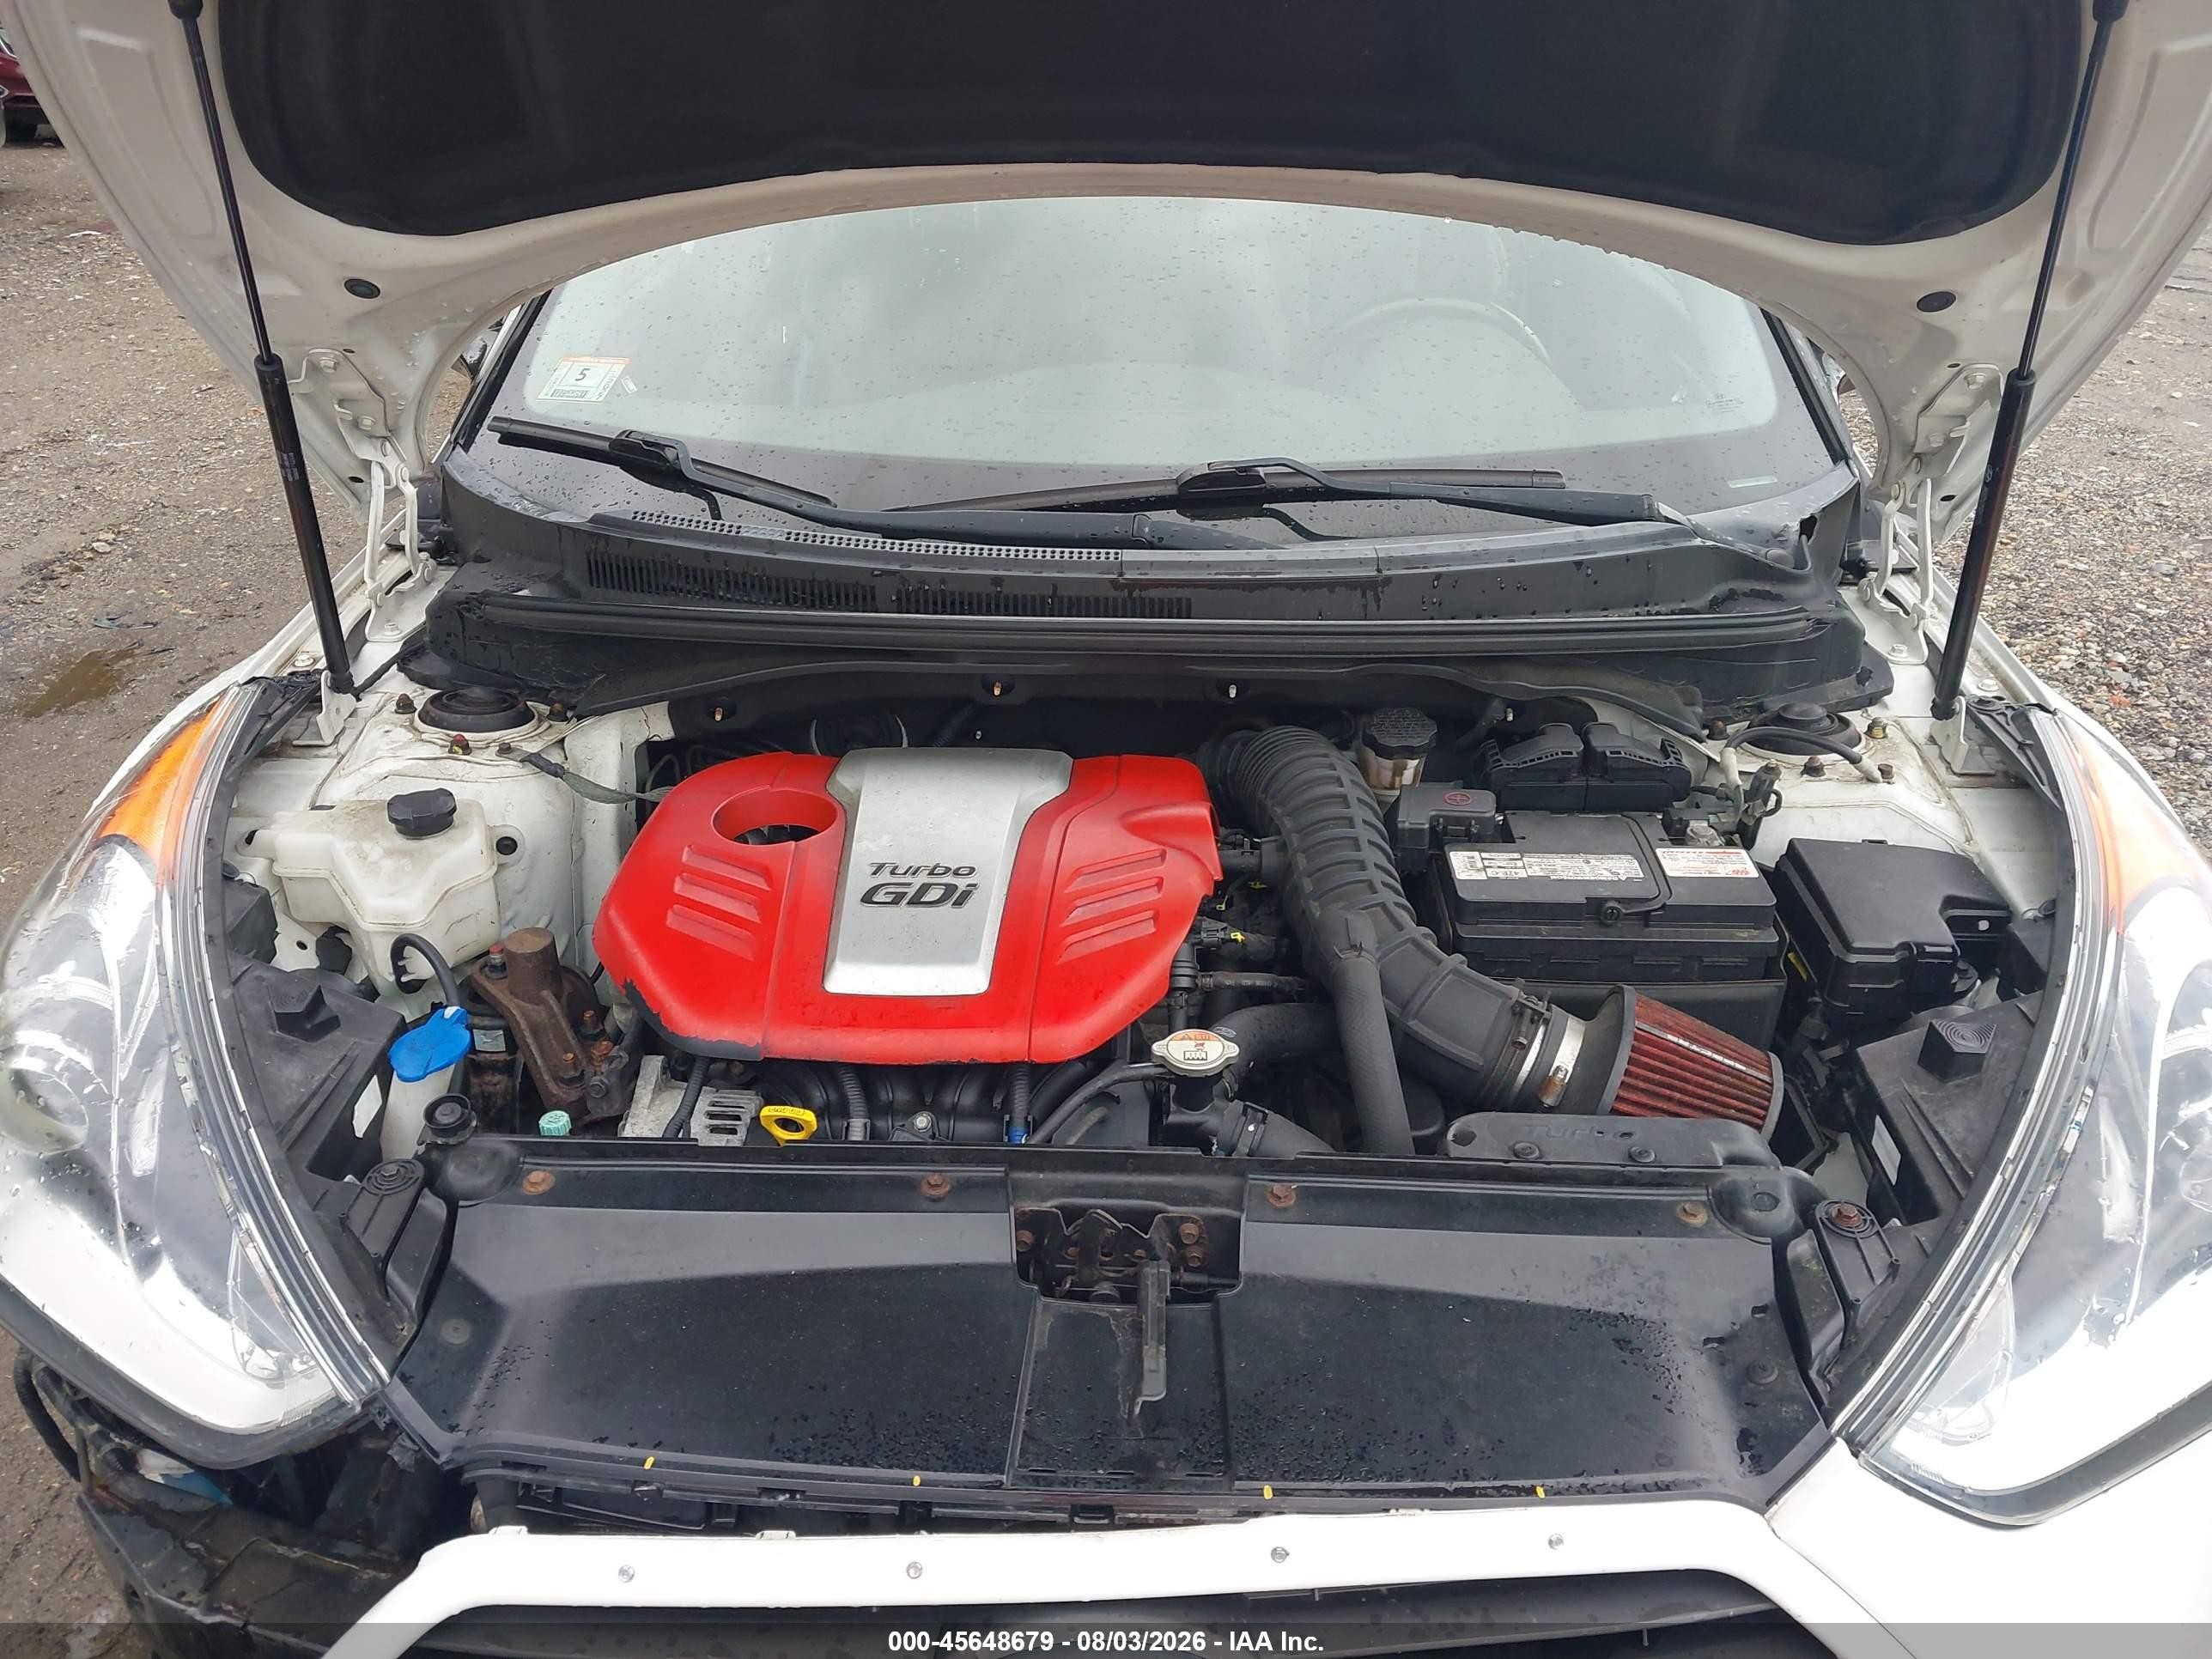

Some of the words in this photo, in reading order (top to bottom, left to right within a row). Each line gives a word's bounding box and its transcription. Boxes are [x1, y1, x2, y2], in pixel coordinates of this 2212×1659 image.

[574, 368, 591, 381] 5
[869, 861, 977, 877] Turbo
[860, 882, 980, 908] GDi
